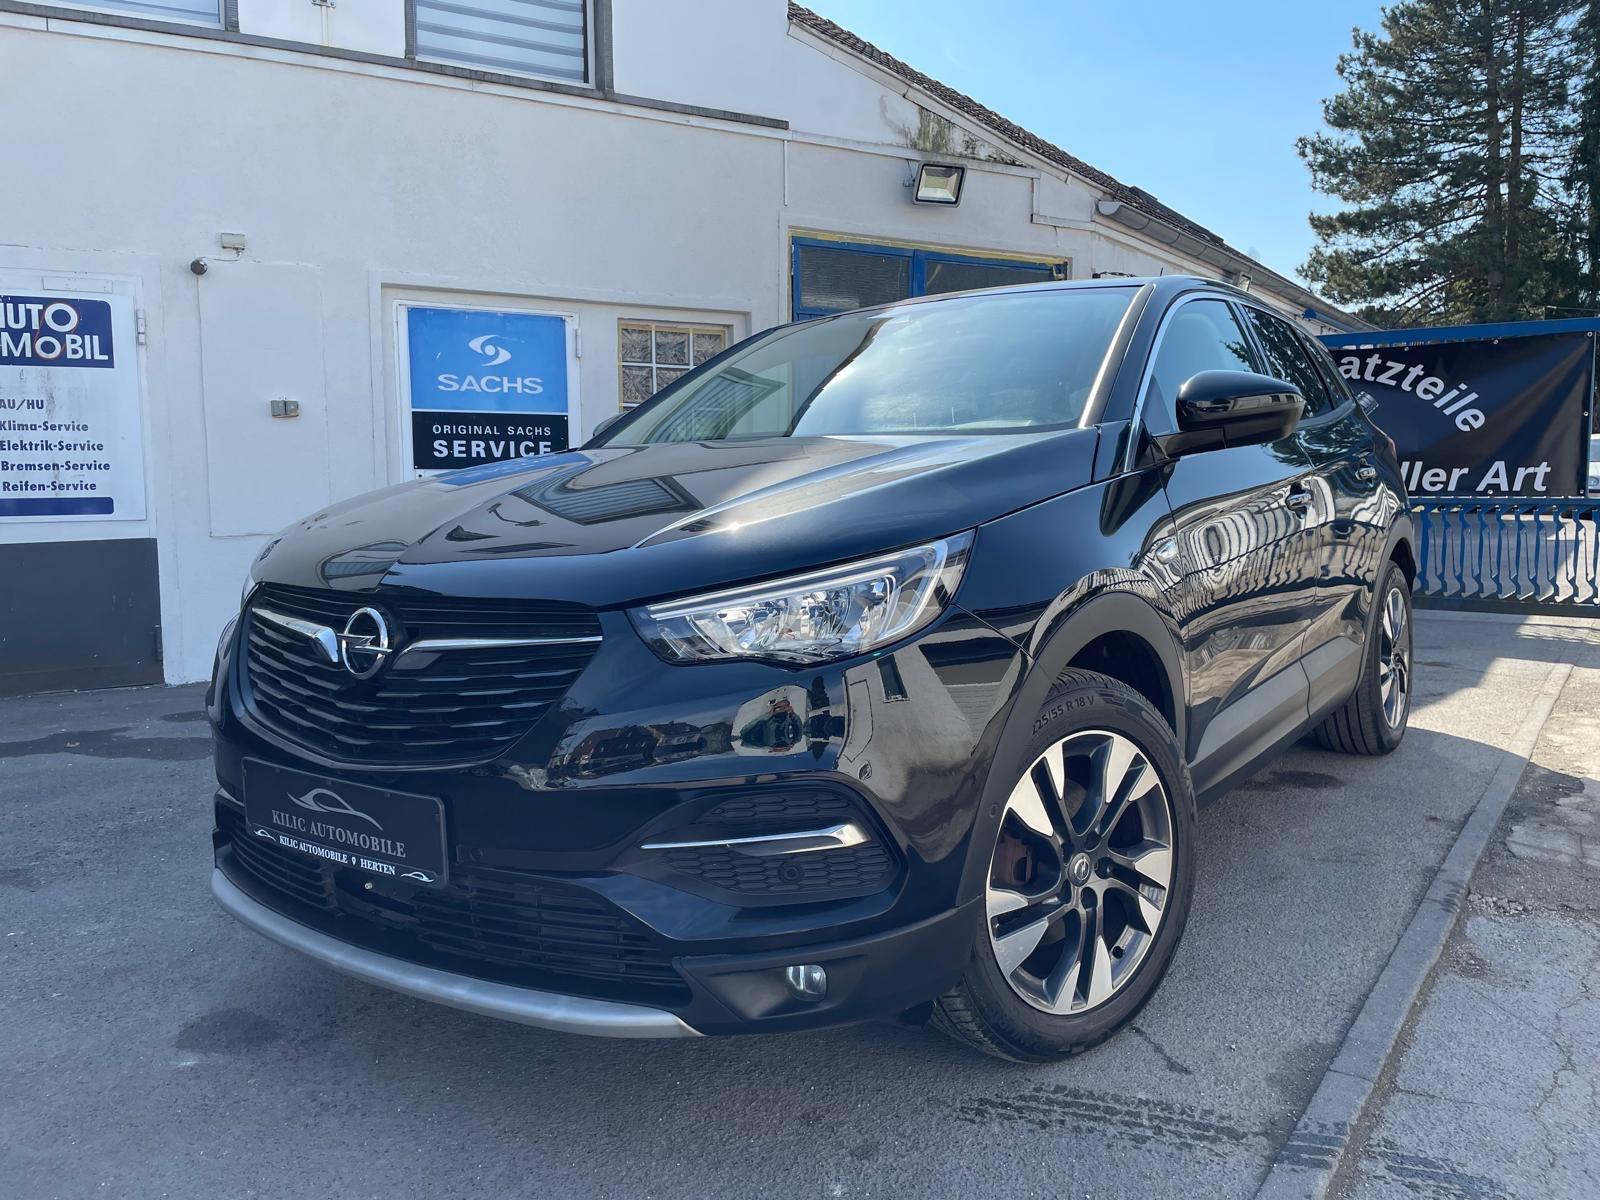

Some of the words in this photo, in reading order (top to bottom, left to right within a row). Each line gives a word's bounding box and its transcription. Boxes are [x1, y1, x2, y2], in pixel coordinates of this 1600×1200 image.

[0, 302, 78, 333] UTO
[1, 331, 109, 361] MOBIL
[437, 373, 544, 394] SACHS
[1338, 353, 1486, 432] atzteile
[0, 399, 45, 411] AU/HU
[0, 420, 89, 432] Klima-Service
[432, 424, 501, 435] ORIGINAL
[507, 425, 551, 436] SACHS
[0, 440, 104, 452] Elektrik-Service
[433, 439, 552, 458] SERVICE
[1, 460, 111, 471] Bremsen-Service
[1475, 460, 1551, 492] Art
[2, 480, 97, 492] Reifen-Service
[1065, 700, 1074, 711] R
[1074, 696, 1086, 707] 18
[1086, 695, 1094, 705] V
[271, 809, 306, 832] KILIC
[310, 822, 407, 858] AUTOMOBILE
[279, 835, 298, 849] KILIC
[299, 842, 348, 864] AUTOMOBILE
[360, 858, 396, 876] HERTEN
